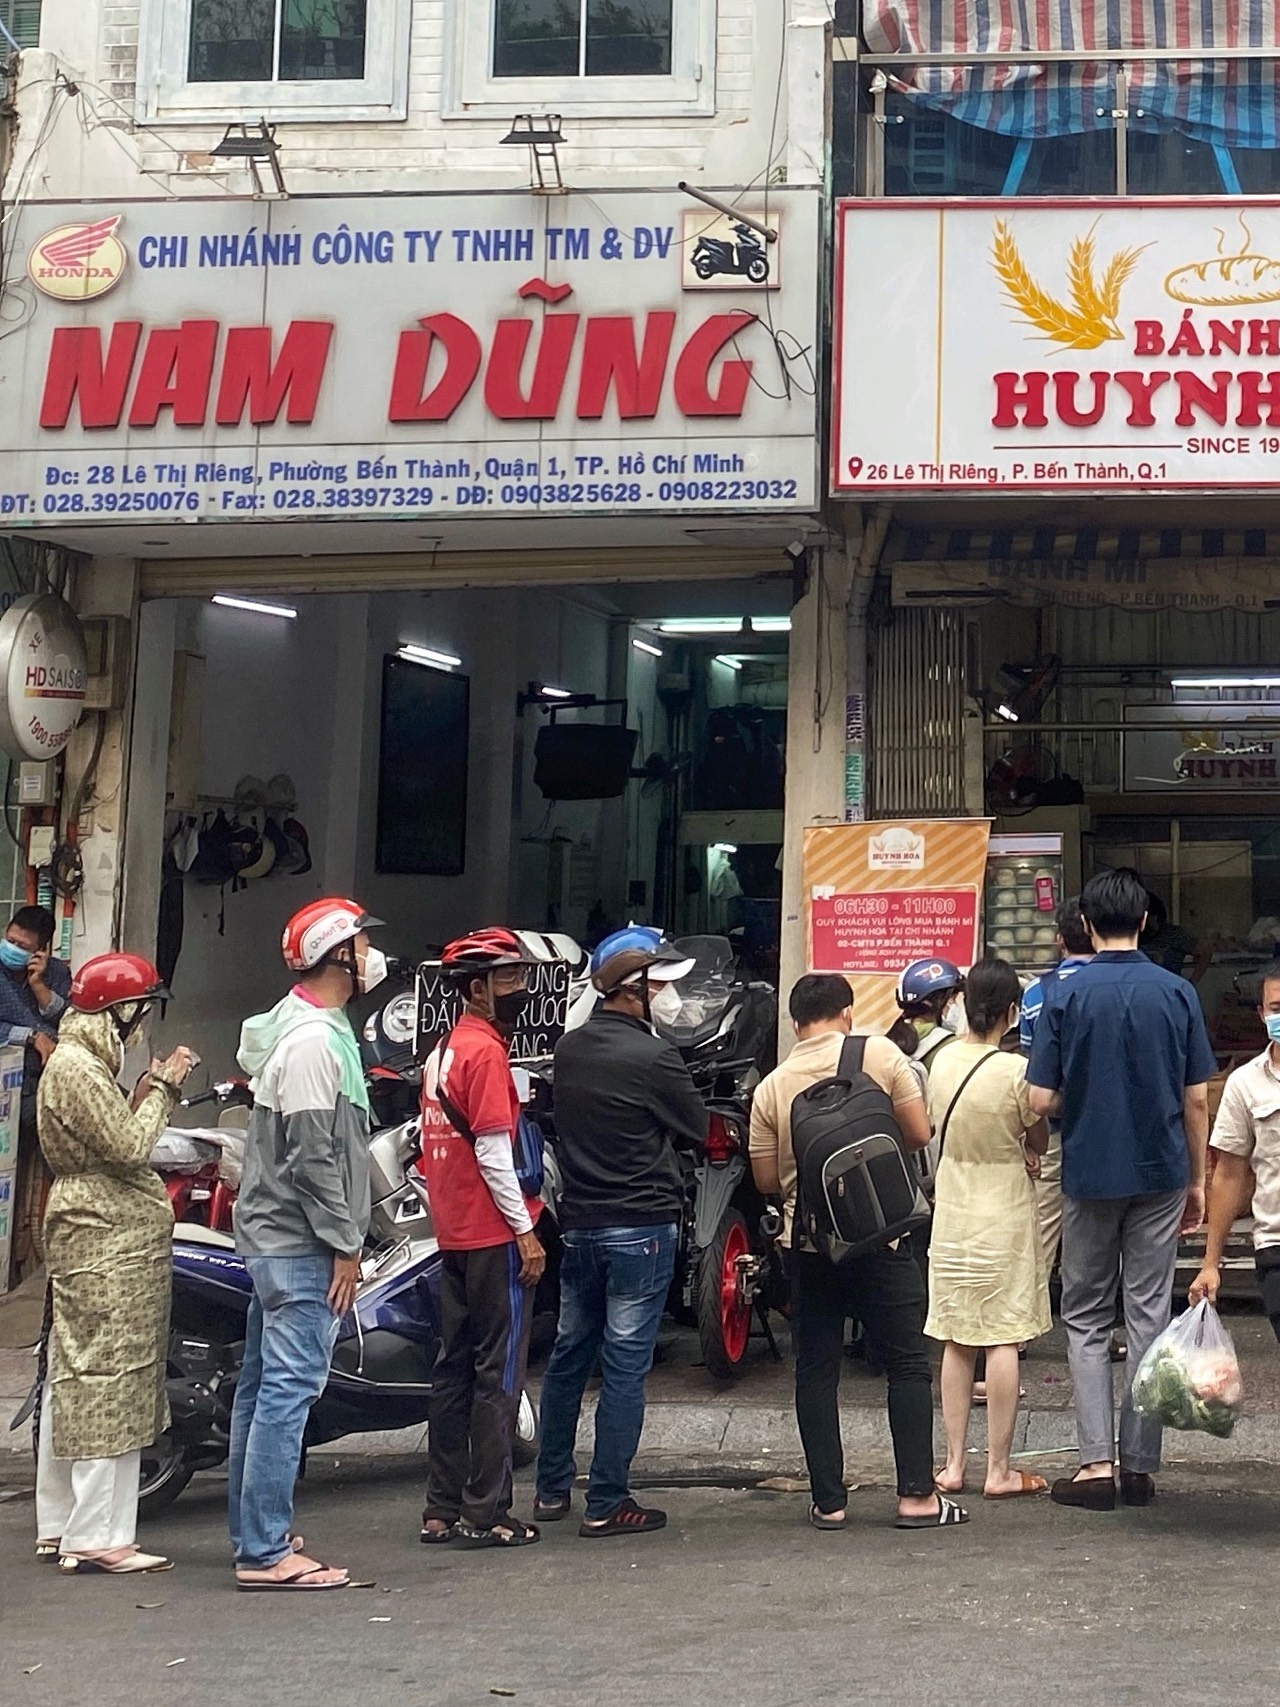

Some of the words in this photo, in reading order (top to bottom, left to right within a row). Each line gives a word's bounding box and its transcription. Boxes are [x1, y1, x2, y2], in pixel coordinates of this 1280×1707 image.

[138, 235, 188, 268] CHI
[200, 227, 301, 267] NHÁNH
[313, 223, 394, 265] CÔNG
[404, 230, 442, 262] TY
[452, 229, 533, 262] TNHH
[545, 228, 589, 260] TM
[600, 227, 622, 260] &
[634, 227, 674, 258] DV
[37, 267, 115, 279] HONDA
[1134, 308, 1280, 356] BÁNH
[39, 320, 334, 431] NAM
[388, 277, 759, 423] DŨNG
[1187, 438, 1250, 454] SINCE
[46, 465, 80, 485] Đc:
[87, 464, 115, 484] 28
[122, 463, 146, 484] Lê
[154, 463, 187, 487] Thị
[269, 460, 348, 484] Phường
[357, 455, 397, 479] Bến
[485, 456, 538, 481] Quận
[575, 456, 609, 476] TP.
[618, 452, 645, 476] Hồ
[653, 454, 688, 474] Chí
[694, 453, 744, 474] Minh
[867, 465, 888, 481] 26
[894, 464, 915, 480] Lê
[920, 463, 944, 483] Thị
[1013, 464, 1029, 480] P.
[1034, 461, 1068, 480] Bến
[43, 491, 199, 514] 028.39250076
[222, 491, 266, 510] Fax:
[273, 487, 433, 509] 028.38397329
[501, 483, 642, 504] 0903825628
[659, 480, 798, 501] 0908223032
[29, 631, 43, 654] XE
[26, 666, 46, 687] HD
[834, 898, 888, 914] 06H30
[903, 897, 956, 914] 11H00
[838, 917, 870, 926] KHÁCH
[914, 917, 933, 925] MUA
